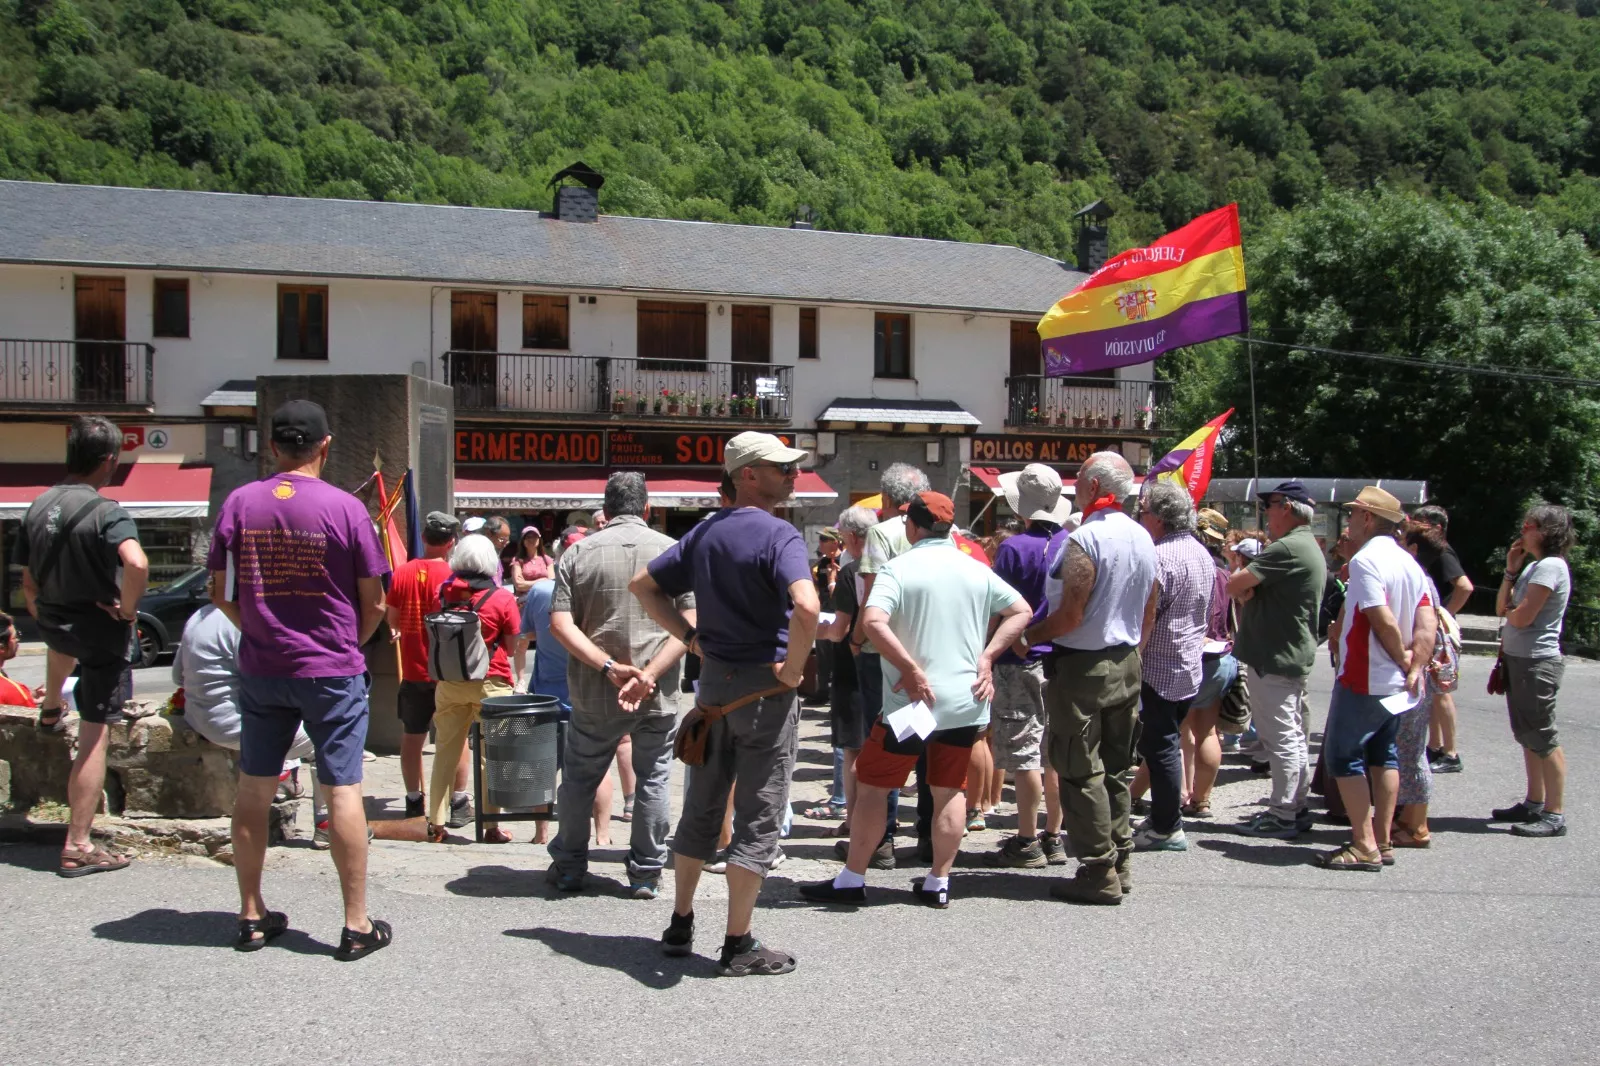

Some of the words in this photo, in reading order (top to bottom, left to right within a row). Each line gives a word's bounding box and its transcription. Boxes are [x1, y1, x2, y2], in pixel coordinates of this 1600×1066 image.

[610, 433, 634, 443] CAVE
[455, 431, 599, 462] ERMERCADO
[611, 444, 644, 453] FRUITS
[973, 439, 1034, 459] POLLOS
[1040, 441, 1061, 460] AL'
[1066, 443, 1097, 460] AST
[611, 455, 663, 464] SOUVENIRS
[456, 498, 583, 508] PERMERCADO
